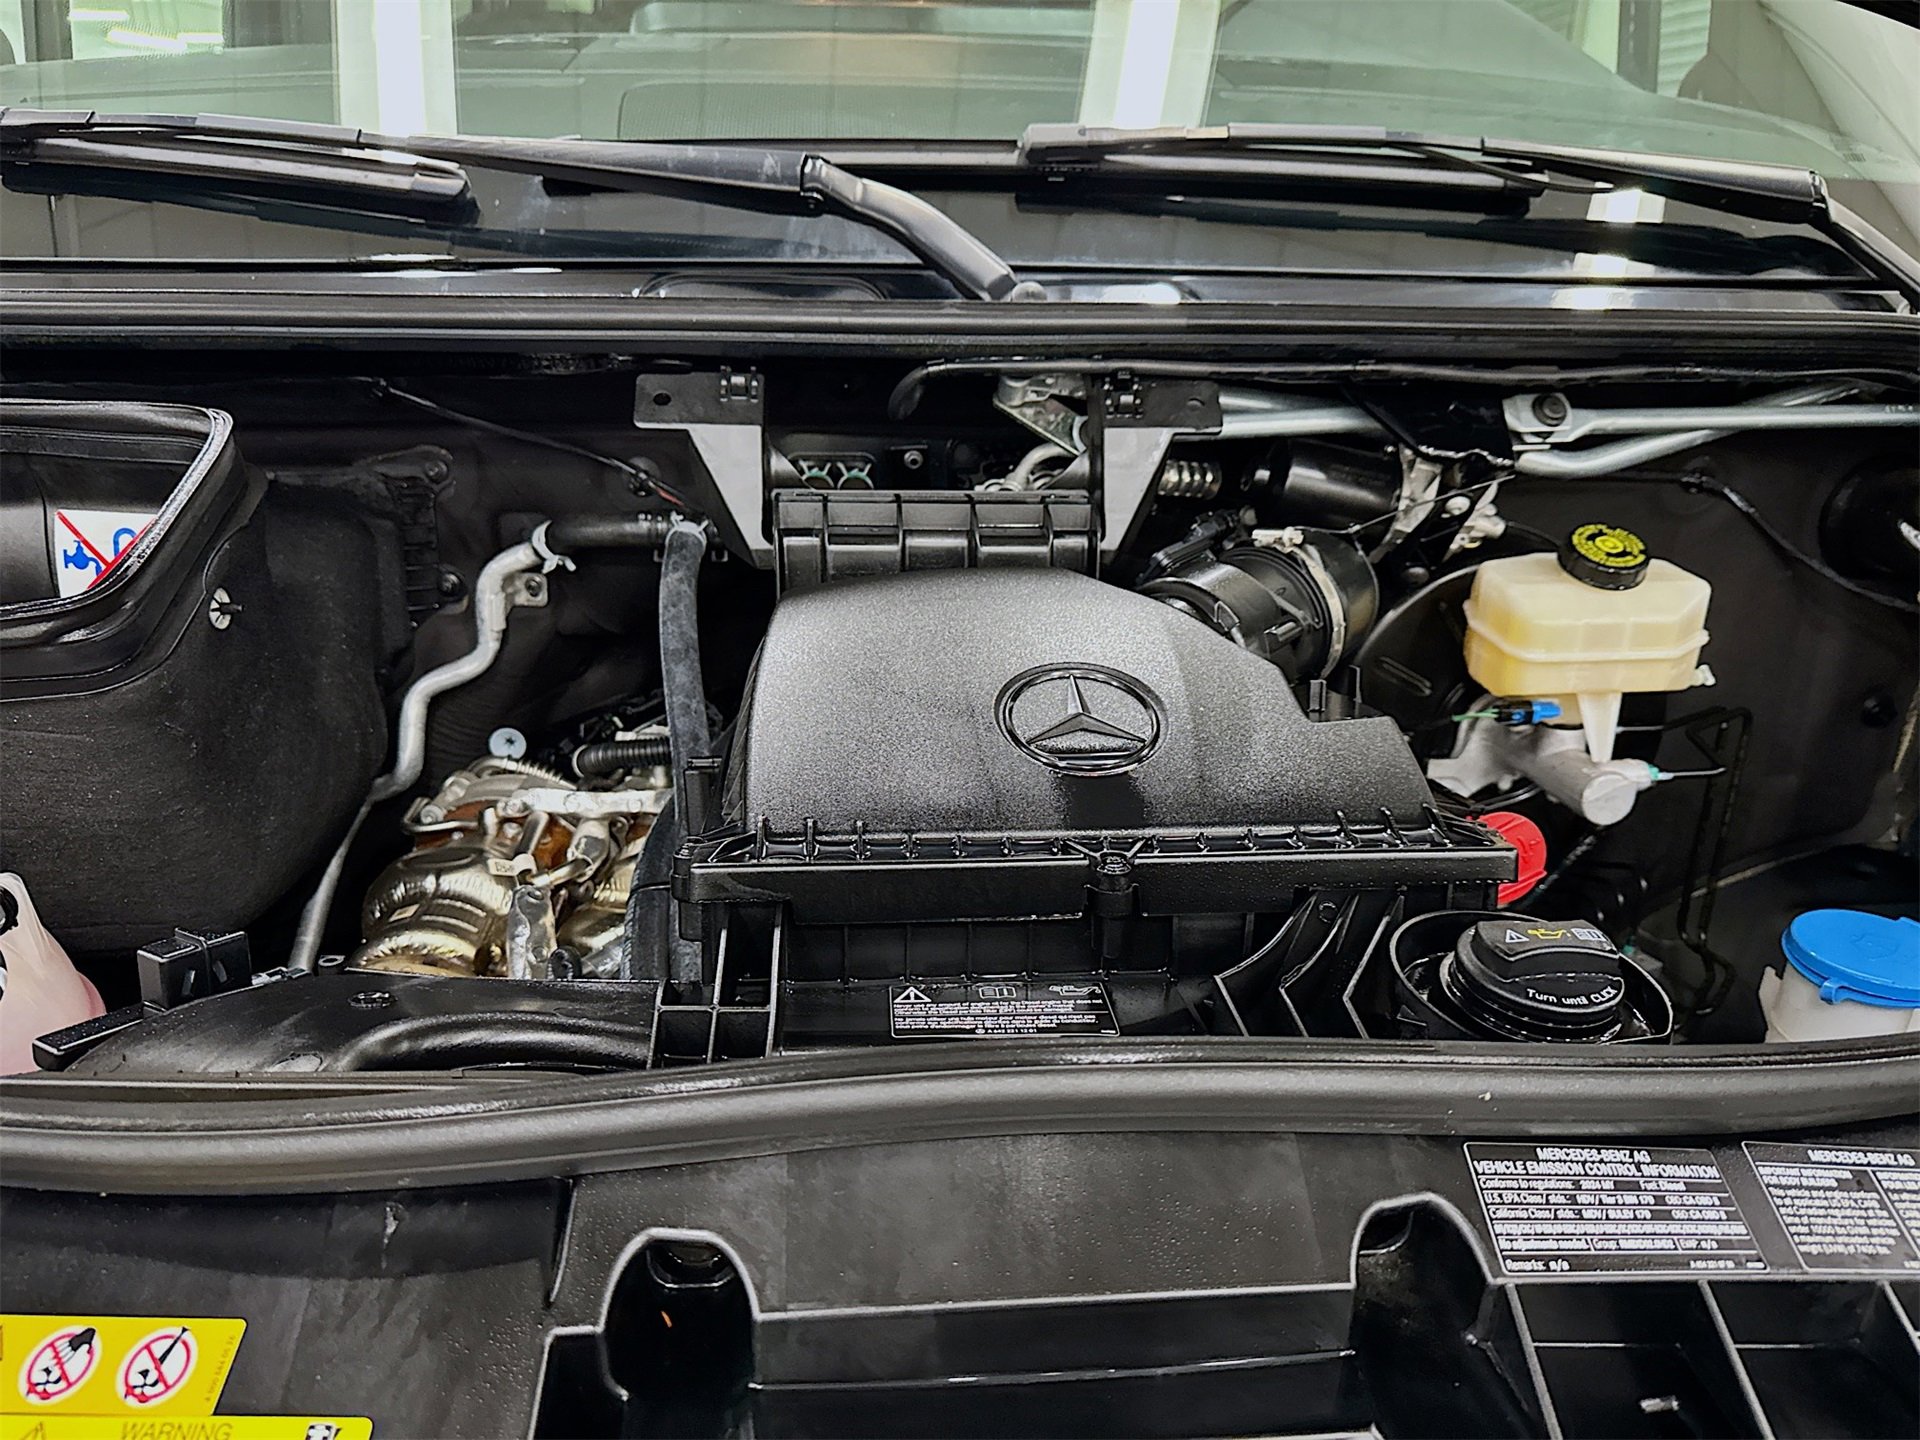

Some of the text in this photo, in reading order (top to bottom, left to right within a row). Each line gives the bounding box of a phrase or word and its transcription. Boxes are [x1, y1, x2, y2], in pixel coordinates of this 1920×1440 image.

[1527, 985, 1618, 1005] Turn until CLICK
[1536, 1147, 1652, 1163] MERCEDES-BENZ AG
[1807, 1149, 1916, 1167] MERCEDES-BENZ AG
[1473, 1160, 1720, 1178] VEHICLE EMISSION CONTROL INFORMATION
[1480, 1178, 1519, 1189] Conforms
[1504, 1259, 1547, 1271] Remarks:
[120, 1422, 233, 1440] WARNING
